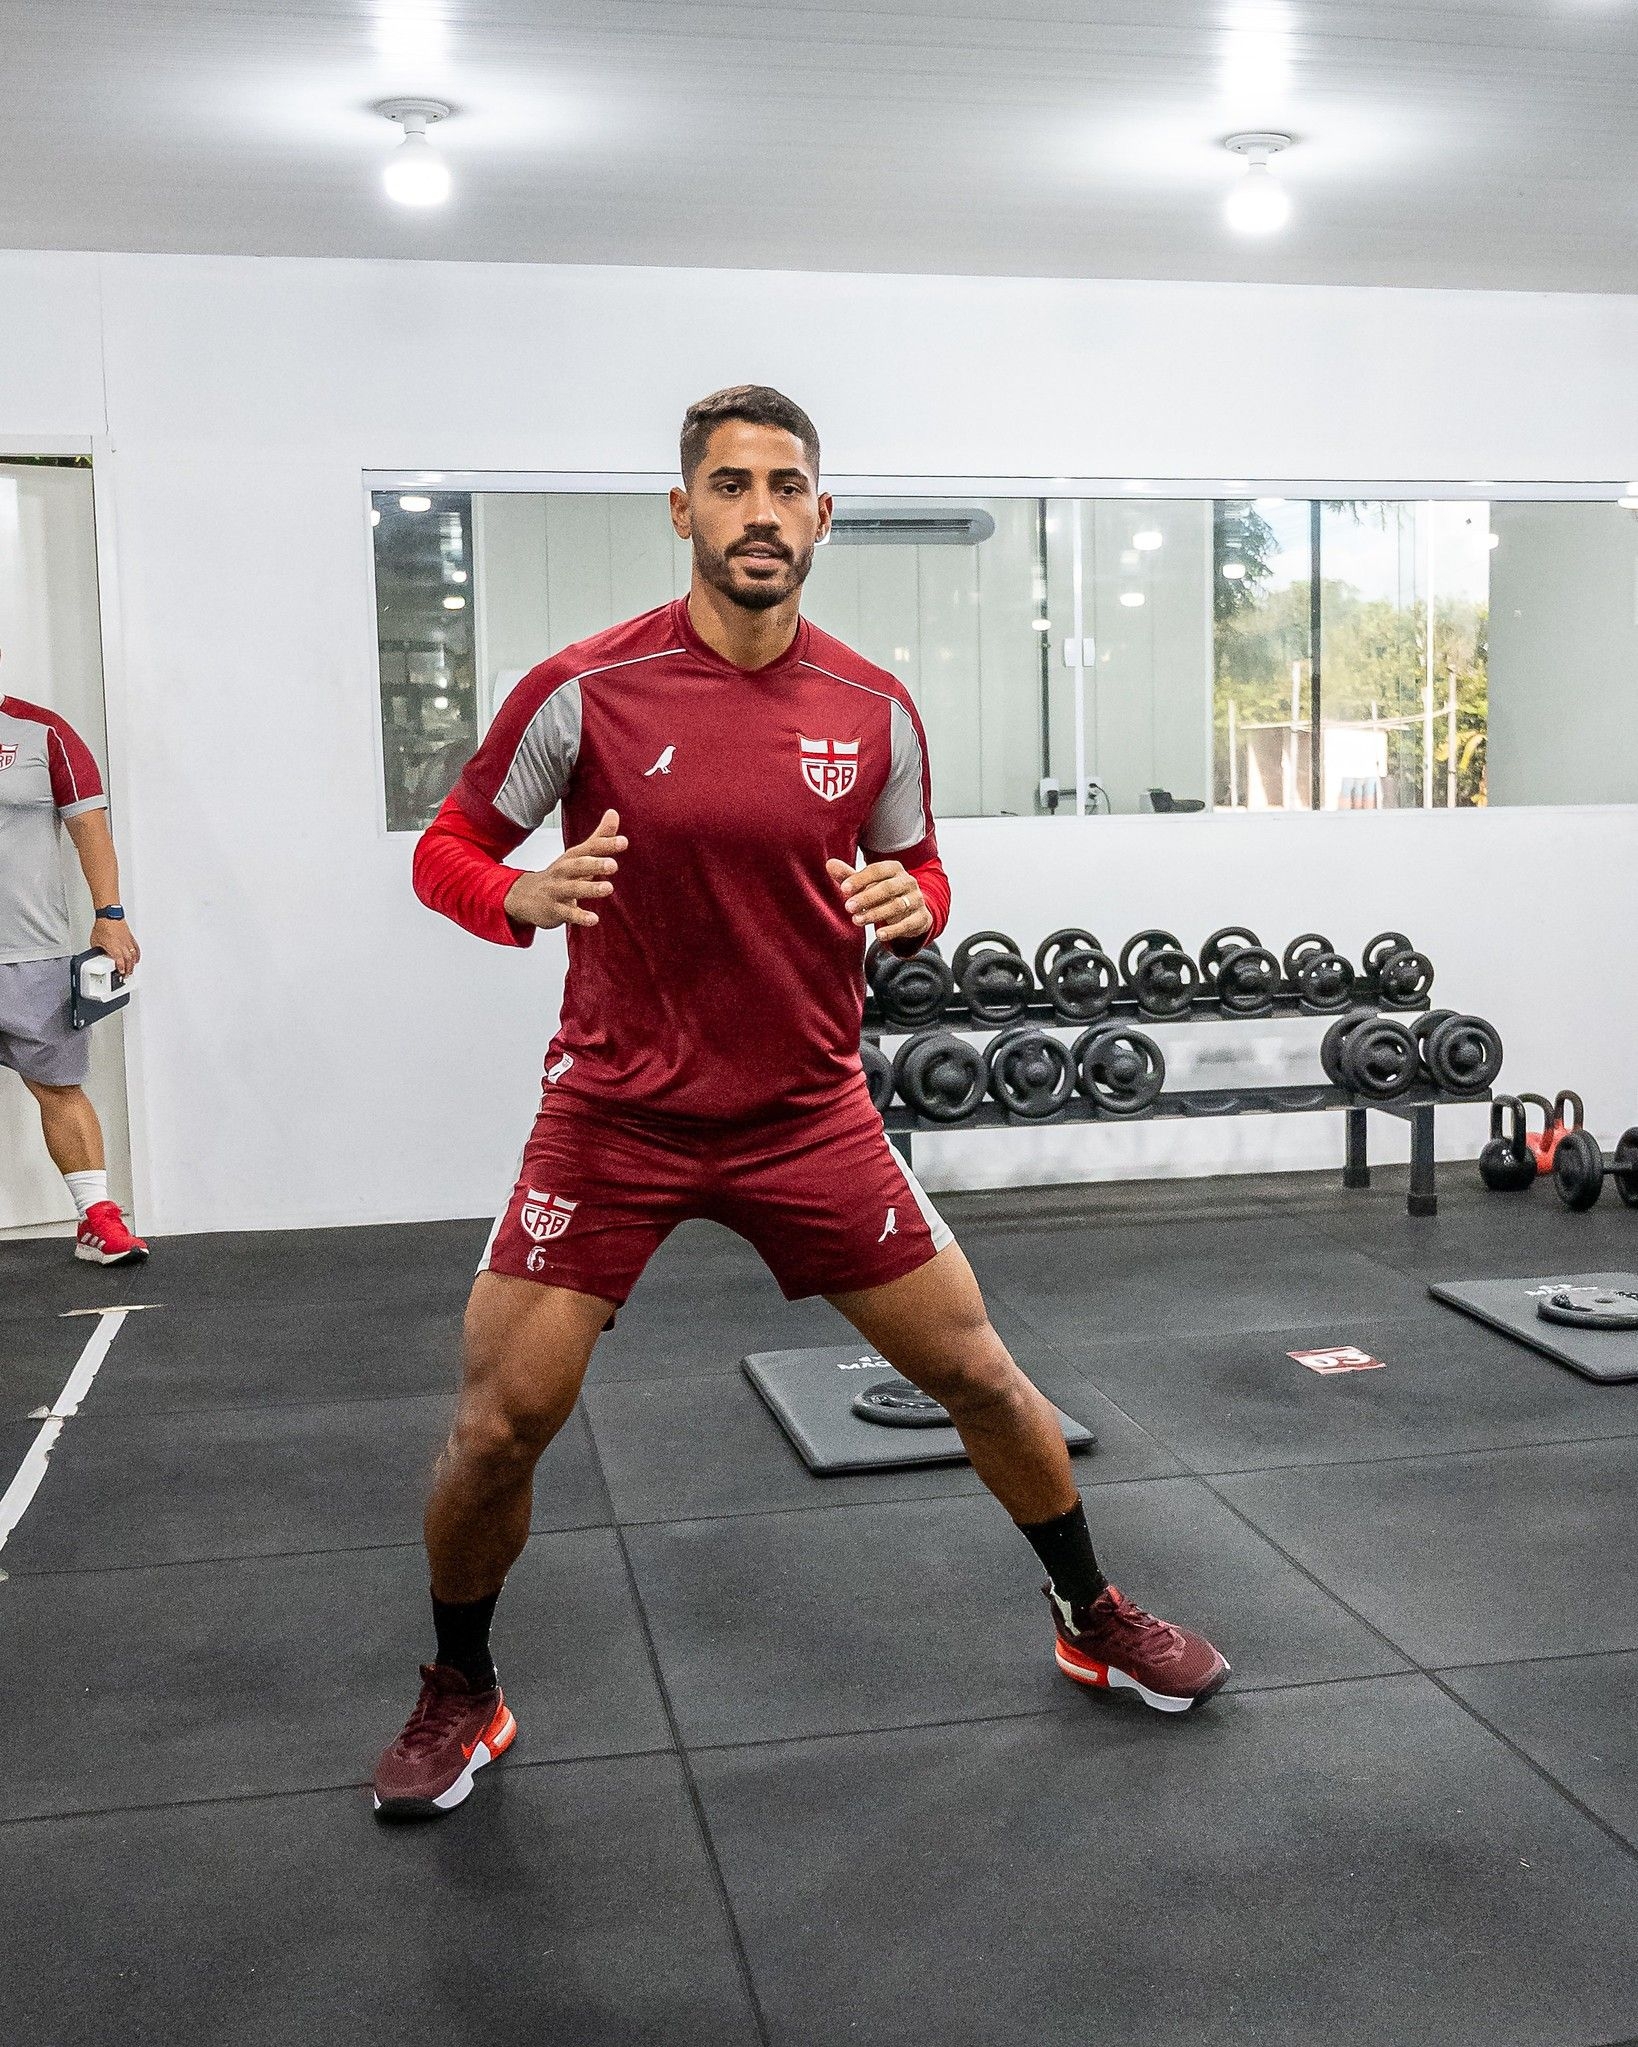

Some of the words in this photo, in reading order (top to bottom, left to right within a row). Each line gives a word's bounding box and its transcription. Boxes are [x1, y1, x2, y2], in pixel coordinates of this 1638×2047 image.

[806, 764, 854, 797] CRB
[524, 1207, 566, 1237] CRB
[526, 1245, 547, 1272] 6
